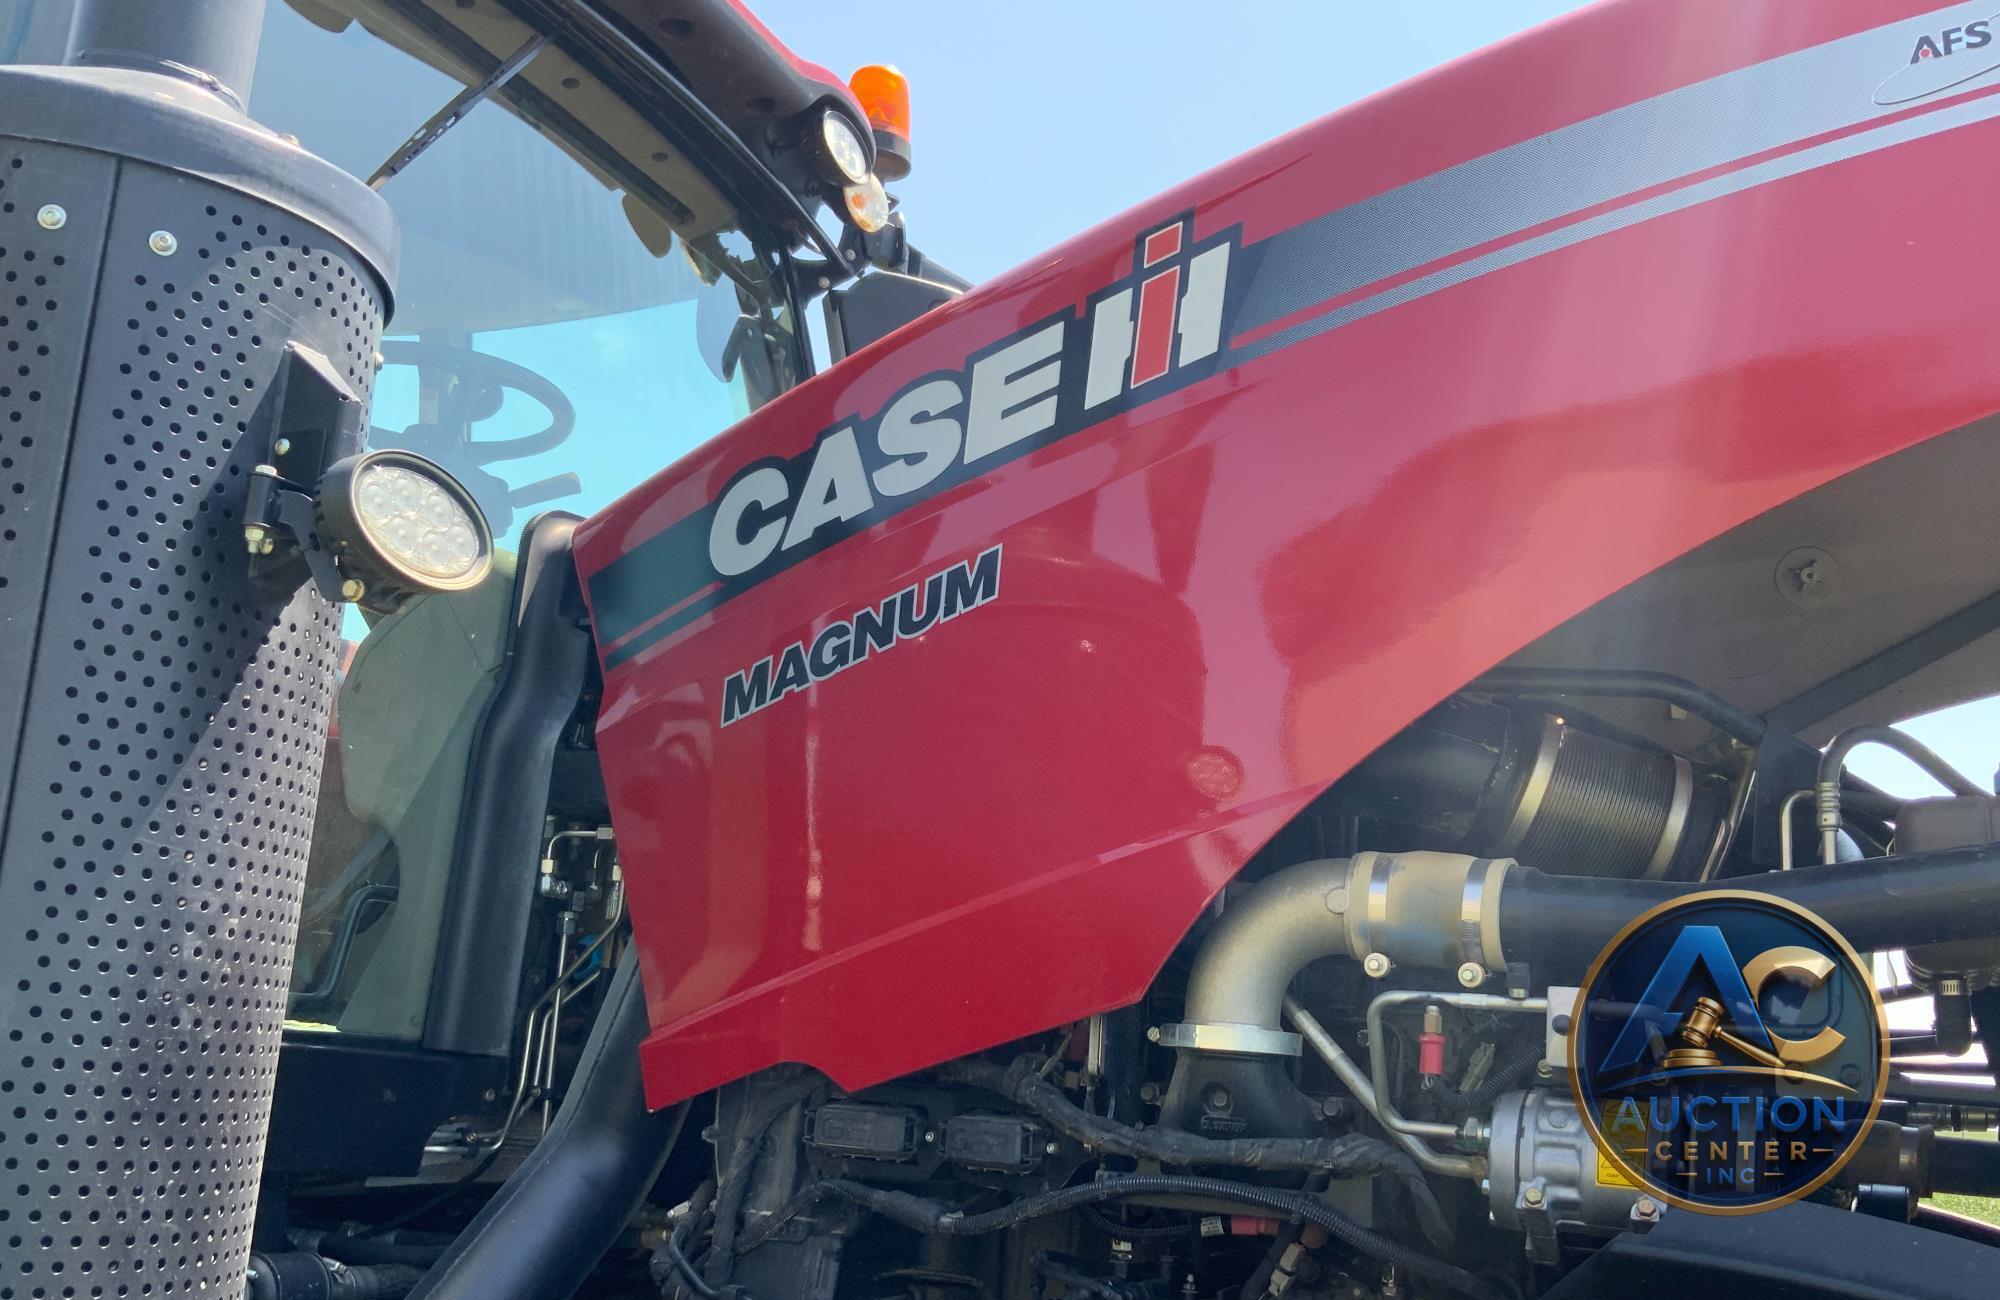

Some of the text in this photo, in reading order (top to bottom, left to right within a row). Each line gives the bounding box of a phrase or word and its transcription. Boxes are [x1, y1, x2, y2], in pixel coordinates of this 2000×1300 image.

[1910, 20, 1992, 65] AFS
[709, 321, 1065, 577] CASE
[720, 543, 1003, 728] MAGNUM
